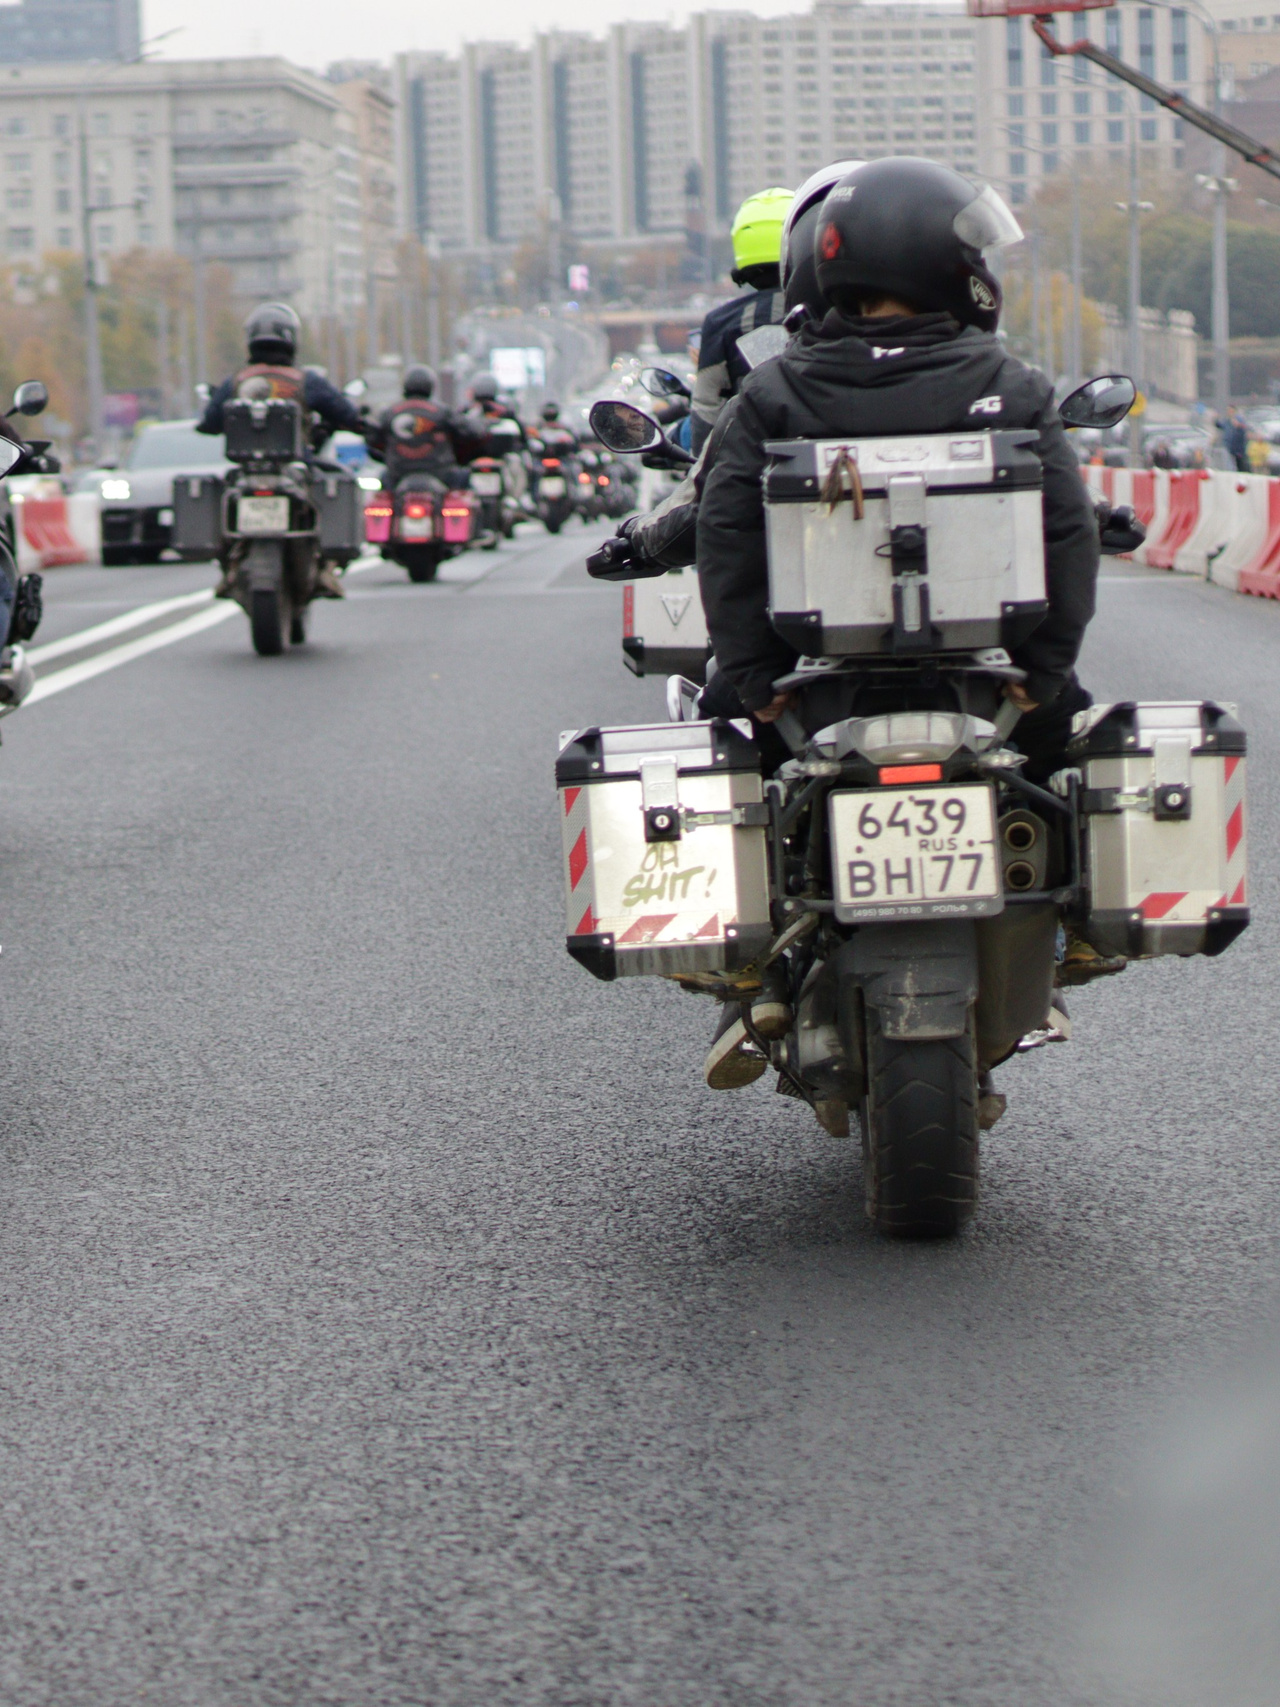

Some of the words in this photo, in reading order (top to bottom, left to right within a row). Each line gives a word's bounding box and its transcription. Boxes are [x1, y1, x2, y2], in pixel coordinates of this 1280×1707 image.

[858, 798, 966, 839] 6439
[919, 837, 958, 851] RUS
[931, 853, 983, 892] 77
[852, 908, 877, 917] (495)
[878, 907, 895, 916] 980
[897, 906, 909, 915] 70
[910, 906, 922, 914] 80
[932, 904, 968, 913] РОЛЬФ
